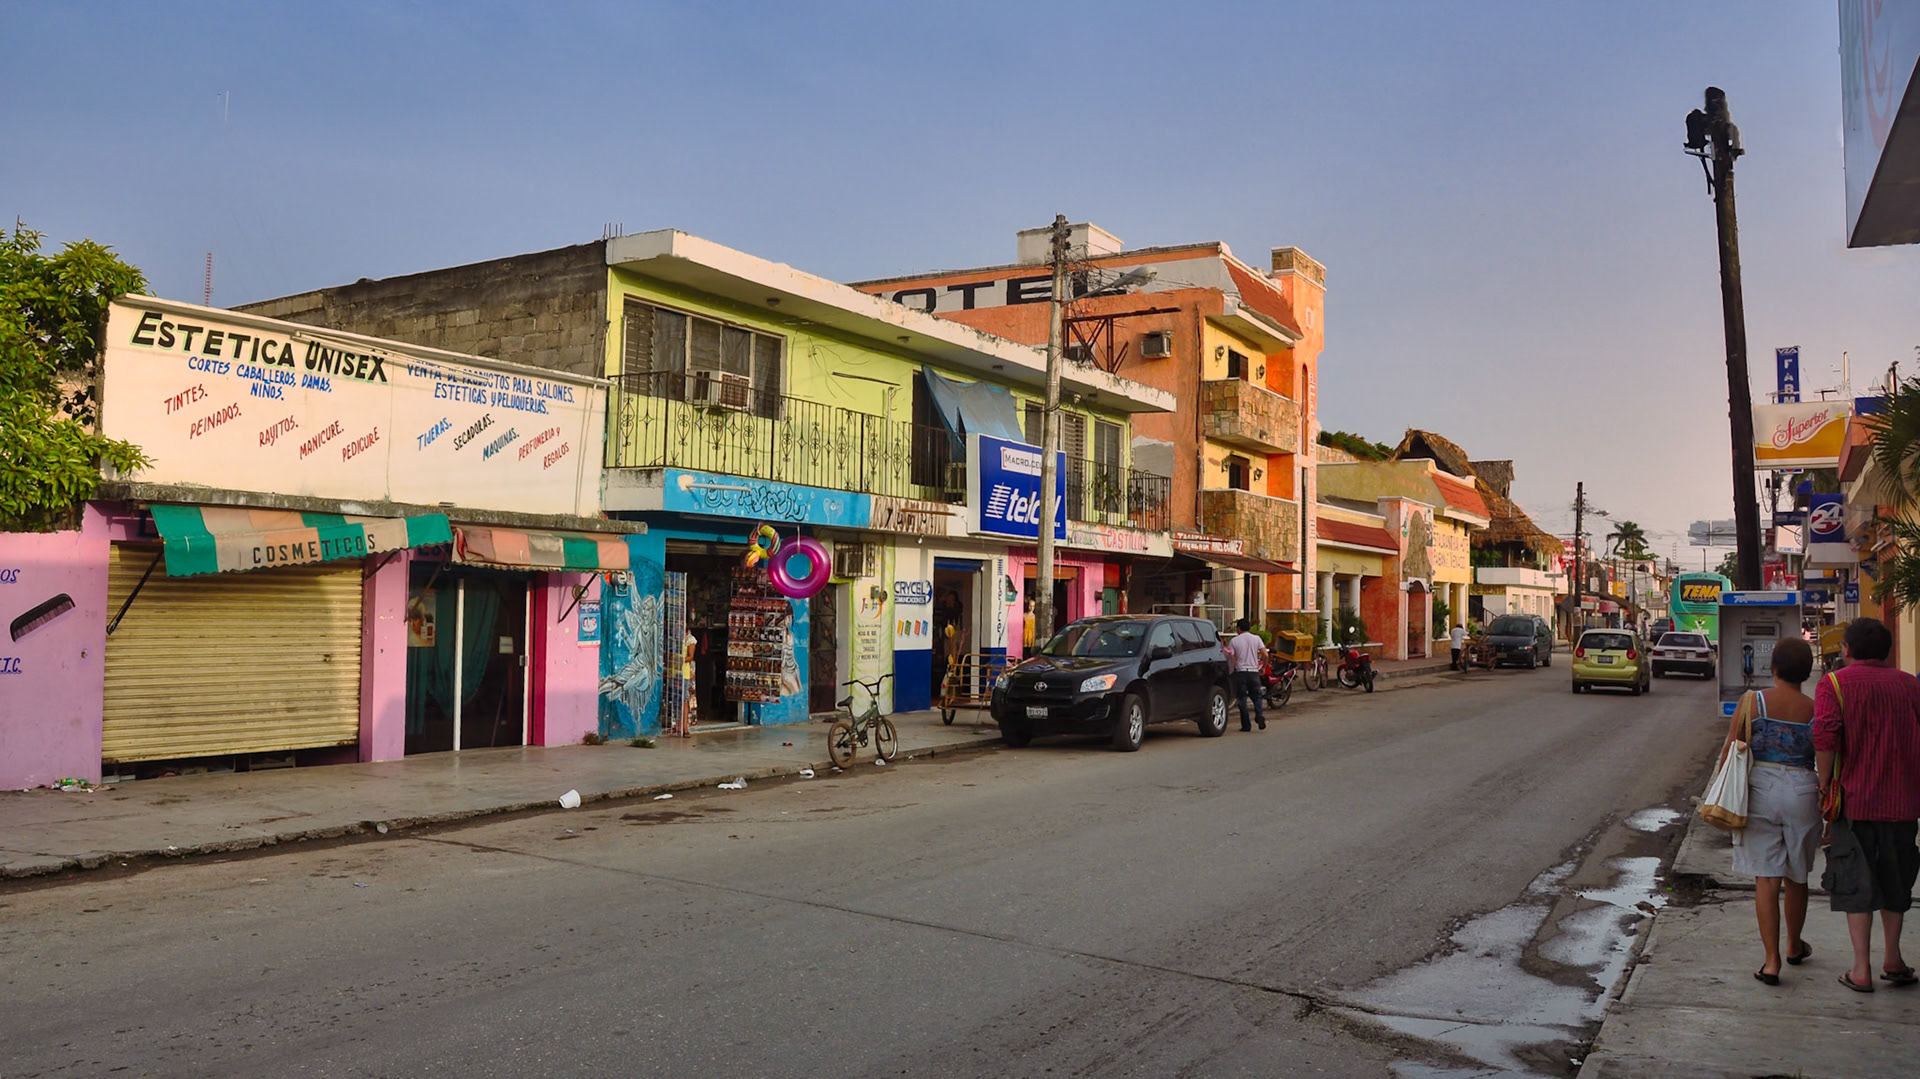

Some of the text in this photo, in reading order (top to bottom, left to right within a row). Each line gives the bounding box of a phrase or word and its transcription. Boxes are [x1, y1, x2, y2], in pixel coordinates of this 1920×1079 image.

[131, 311, 388, 383] ESTETICA UNISEX
[188, 356, 332, 393] CORTES CABALLEROS, DAMAS,
[250, 380, 284, 401] NIÑOS.
[513, 376, 532, 396] PARA
[164, 383, 208, 415] TINTES.
[434, 383, 487, 405] ESTETICAS
[189, 402, 242, 439] PEINADOS.
[259, 415, 299, 447] RAYITOS.
[416, 417, 452, 451] TIJERAS.
[453, 413, 495, 451] SECADORAS.
[1772, 409, 1829, 448] Superior
[300, 420, 344, 460] MANICURE.
[342, 426, 380, 462] PEDICURE
[482, 427, 520, 462] MAQUINAS.
[518, 428, 555, 461] PERFUMERIA
[543, 442, 570, 470] REGALOS
[1006, 488, 1062, 525] telcl
[1811, 504, 1840, 530] 24
[253, 533, 377, 565] COSMETICOS
[0, 569, 21, 584] OS
[894, 580, 927, 596] CRYCEL
